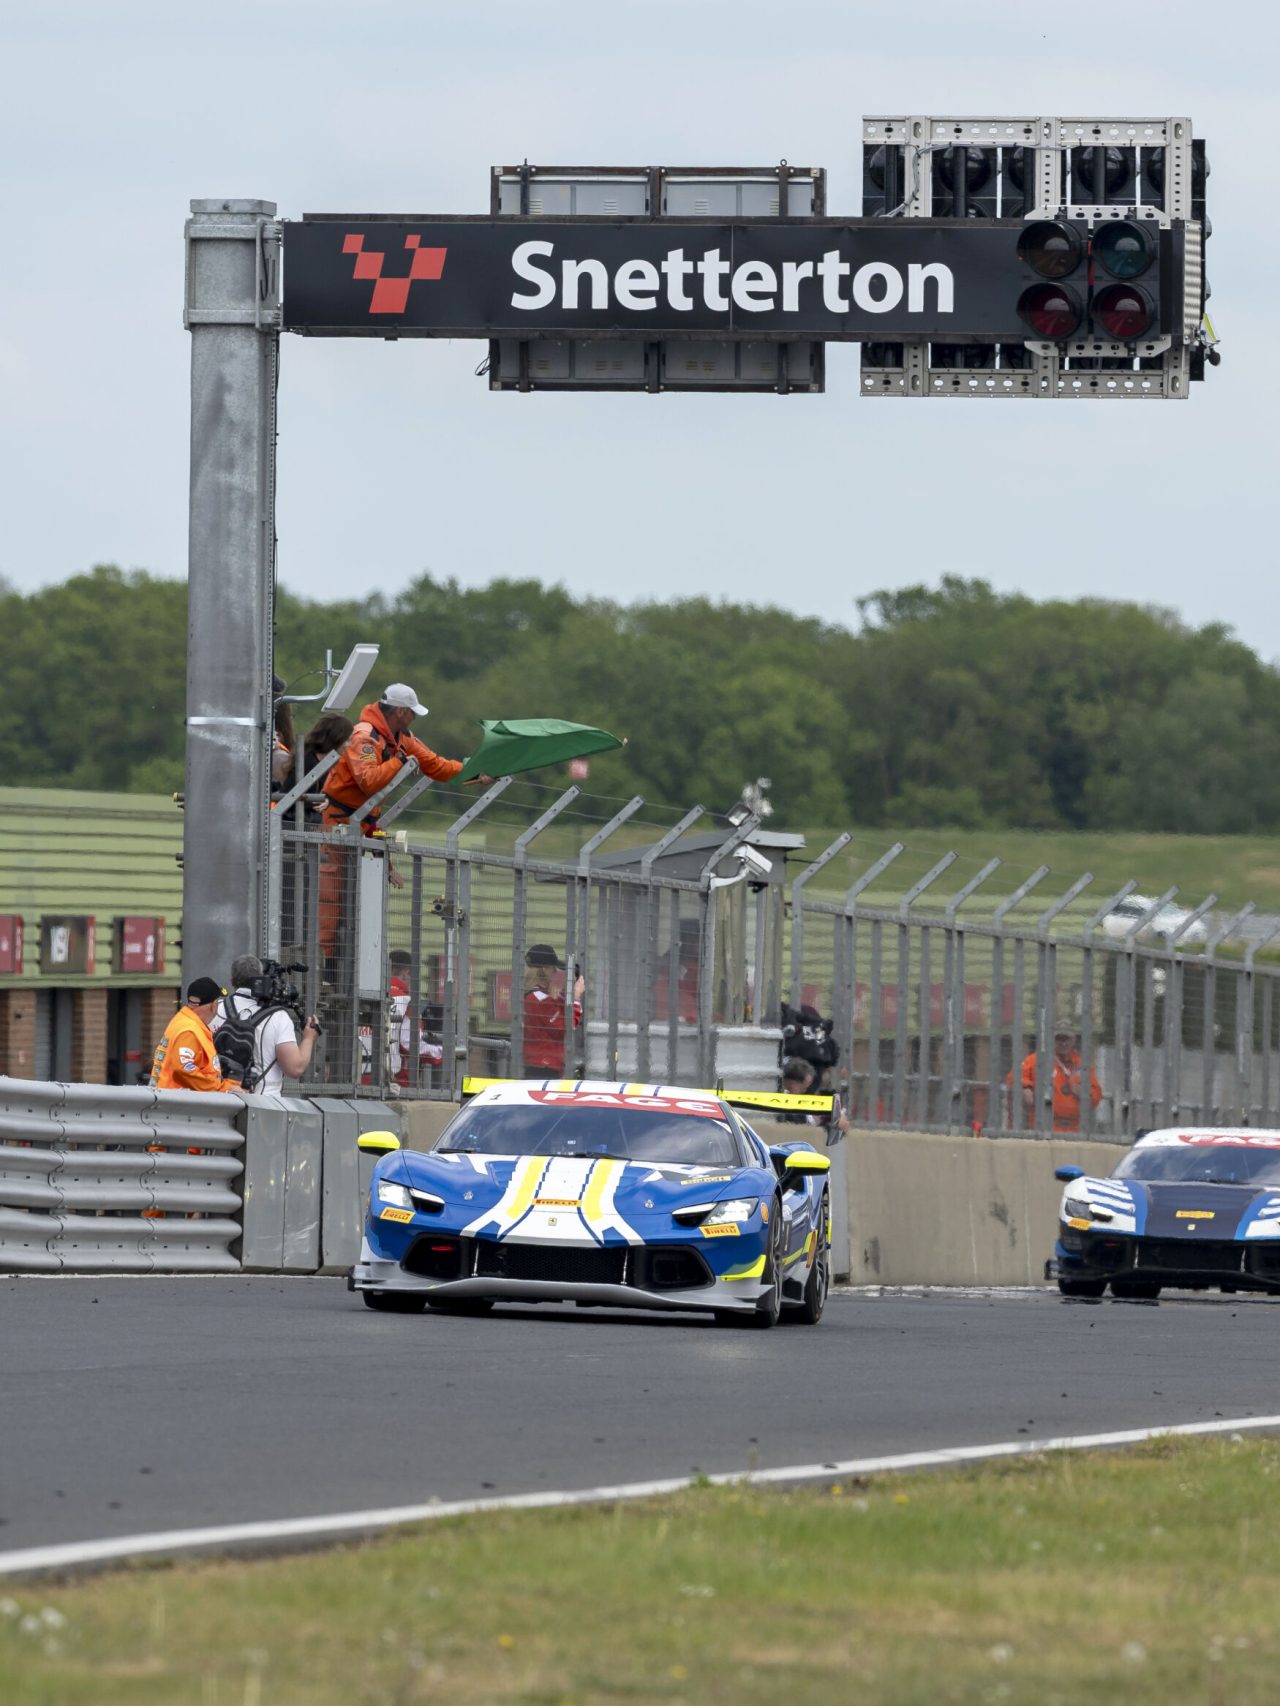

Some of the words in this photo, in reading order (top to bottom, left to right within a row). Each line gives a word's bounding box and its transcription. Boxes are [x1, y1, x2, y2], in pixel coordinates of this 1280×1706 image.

[511, 240, 953, 312] Snetterton
[543, 1091, 719, 1113] FAGE
[704, 1225, 737, 1235] PIRELLI
